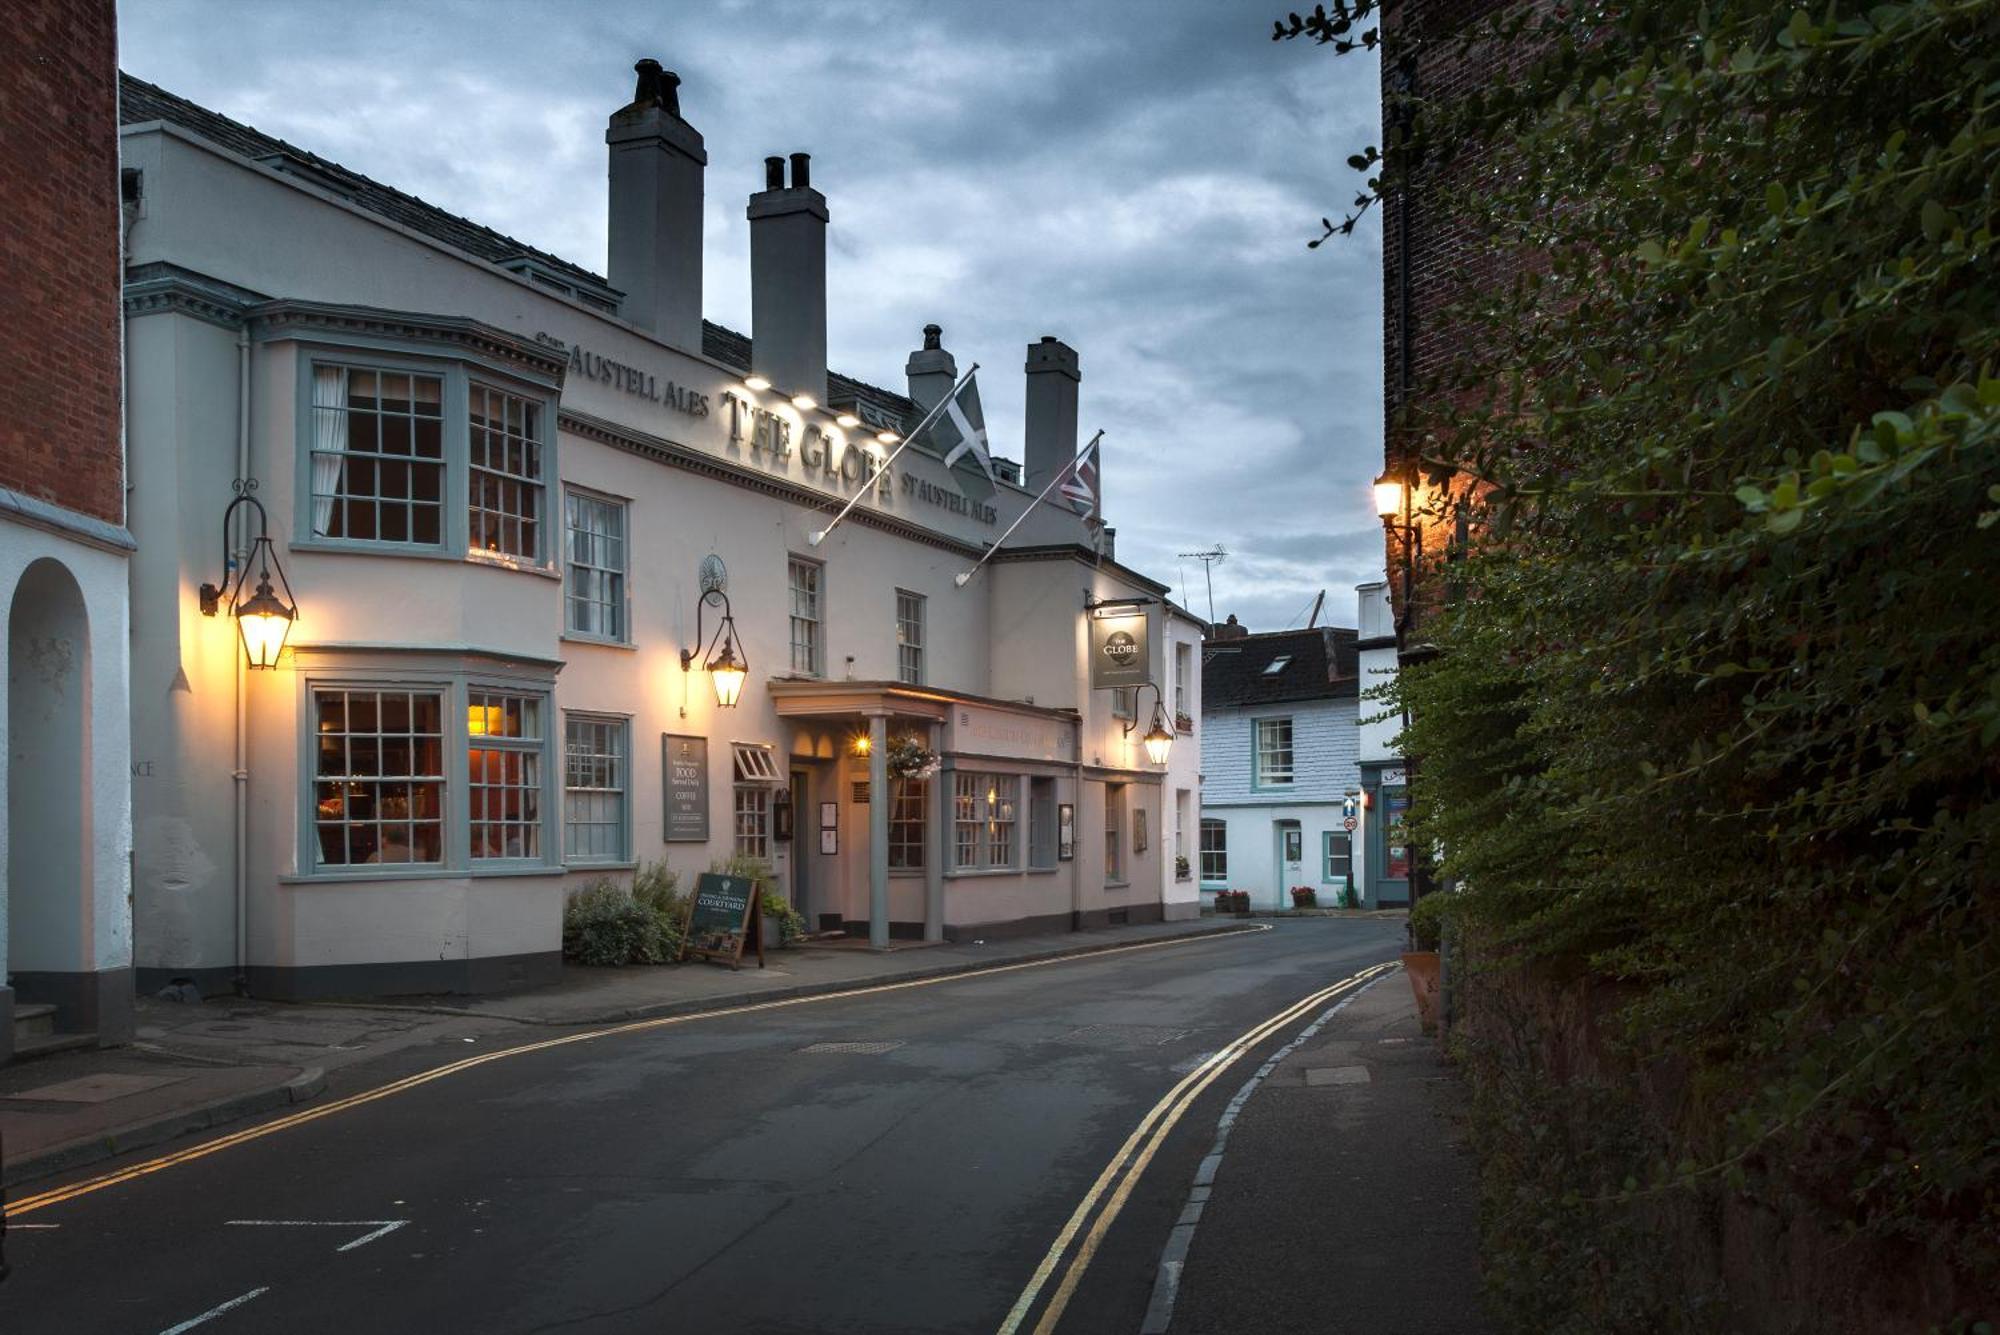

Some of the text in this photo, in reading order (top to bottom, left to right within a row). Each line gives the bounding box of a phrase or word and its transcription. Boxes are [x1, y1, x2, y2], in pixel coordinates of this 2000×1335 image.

[569, 345, 660, 402] AUSTELL
[663, 381, 710, 418] ALES
[721, 391, 791, 459] THE
[919, 480, 970, 517] AUSTELL
[1103, 645, 1138, 655] GLOBE
